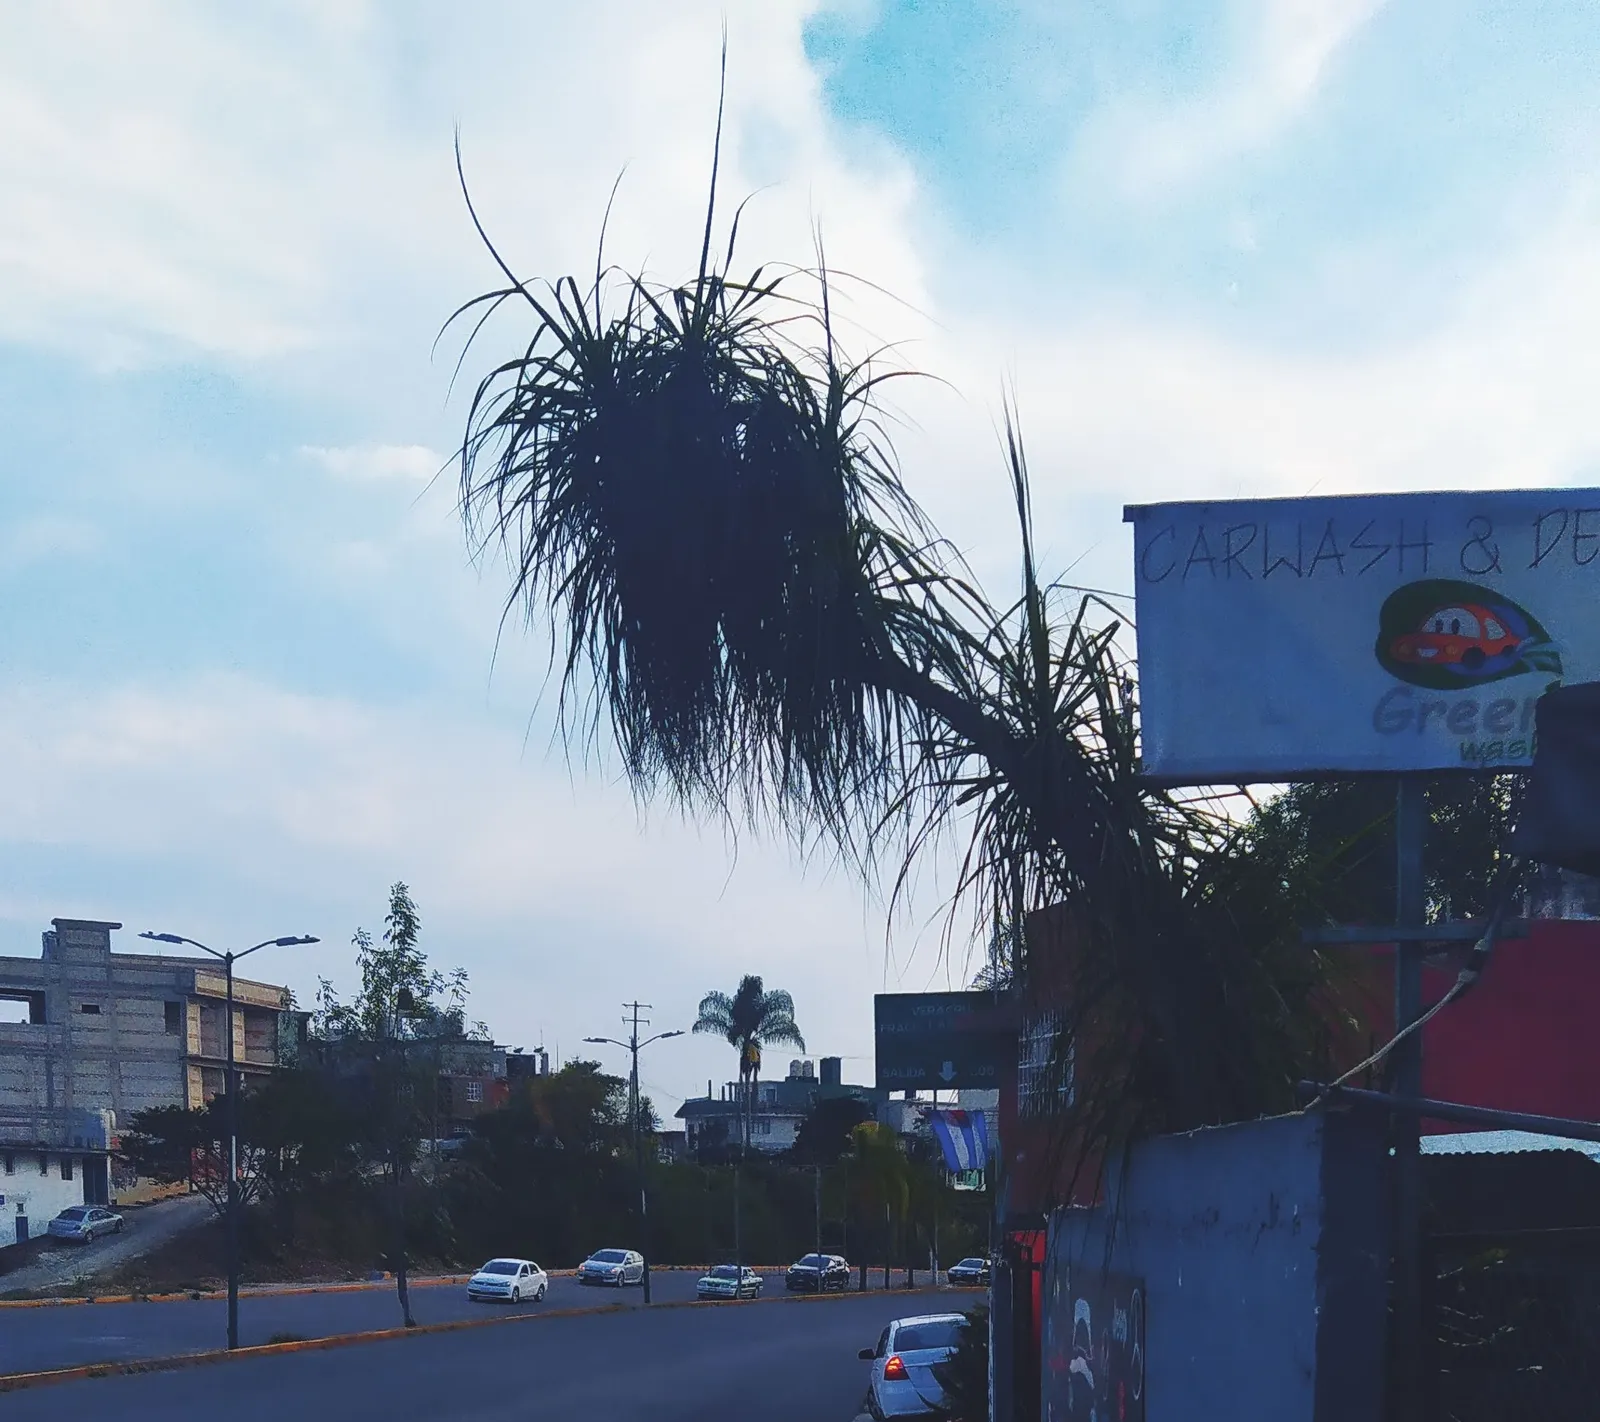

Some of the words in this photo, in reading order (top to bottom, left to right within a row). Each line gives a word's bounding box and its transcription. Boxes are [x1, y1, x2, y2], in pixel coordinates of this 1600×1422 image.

[1141, 519, 1434, 583] CARWASH
[1459, 514, 1502, 575] &
[882, 1066, 926, 1078] SALIDA
